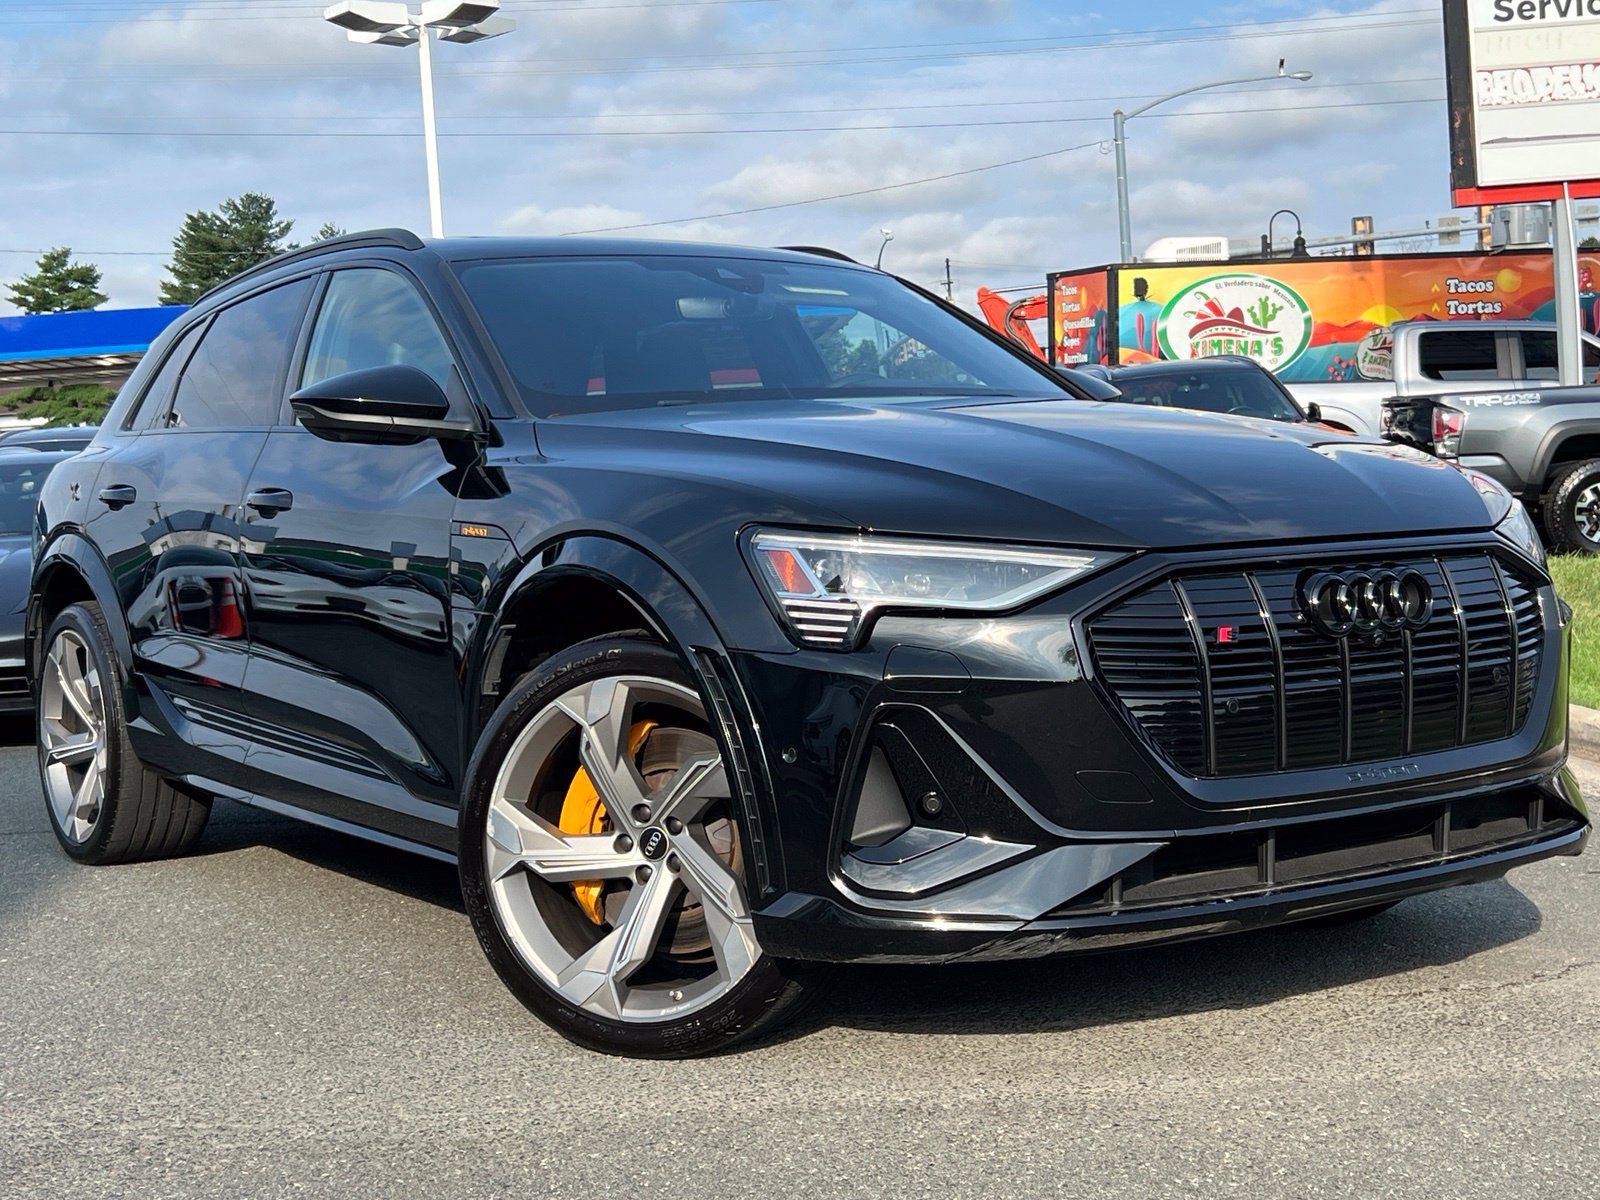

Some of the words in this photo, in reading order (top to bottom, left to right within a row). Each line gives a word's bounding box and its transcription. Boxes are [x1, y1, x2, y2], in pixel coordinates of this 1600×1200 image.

[1062, 285, 1078, 296] Tacos
[1446, 279, 1494, 293] Tacos
[1062, 302, 1080, 313] Tortas
[1446, 300, 1502, 315] Tortas
[1063, 316, 1096, 332] Quesadillas
[1063, 335, 1080, 349] Sopes
[1190, 336, 1284, 358] XIMENA'S
[1064, 352, 1089, 364] Burritos
